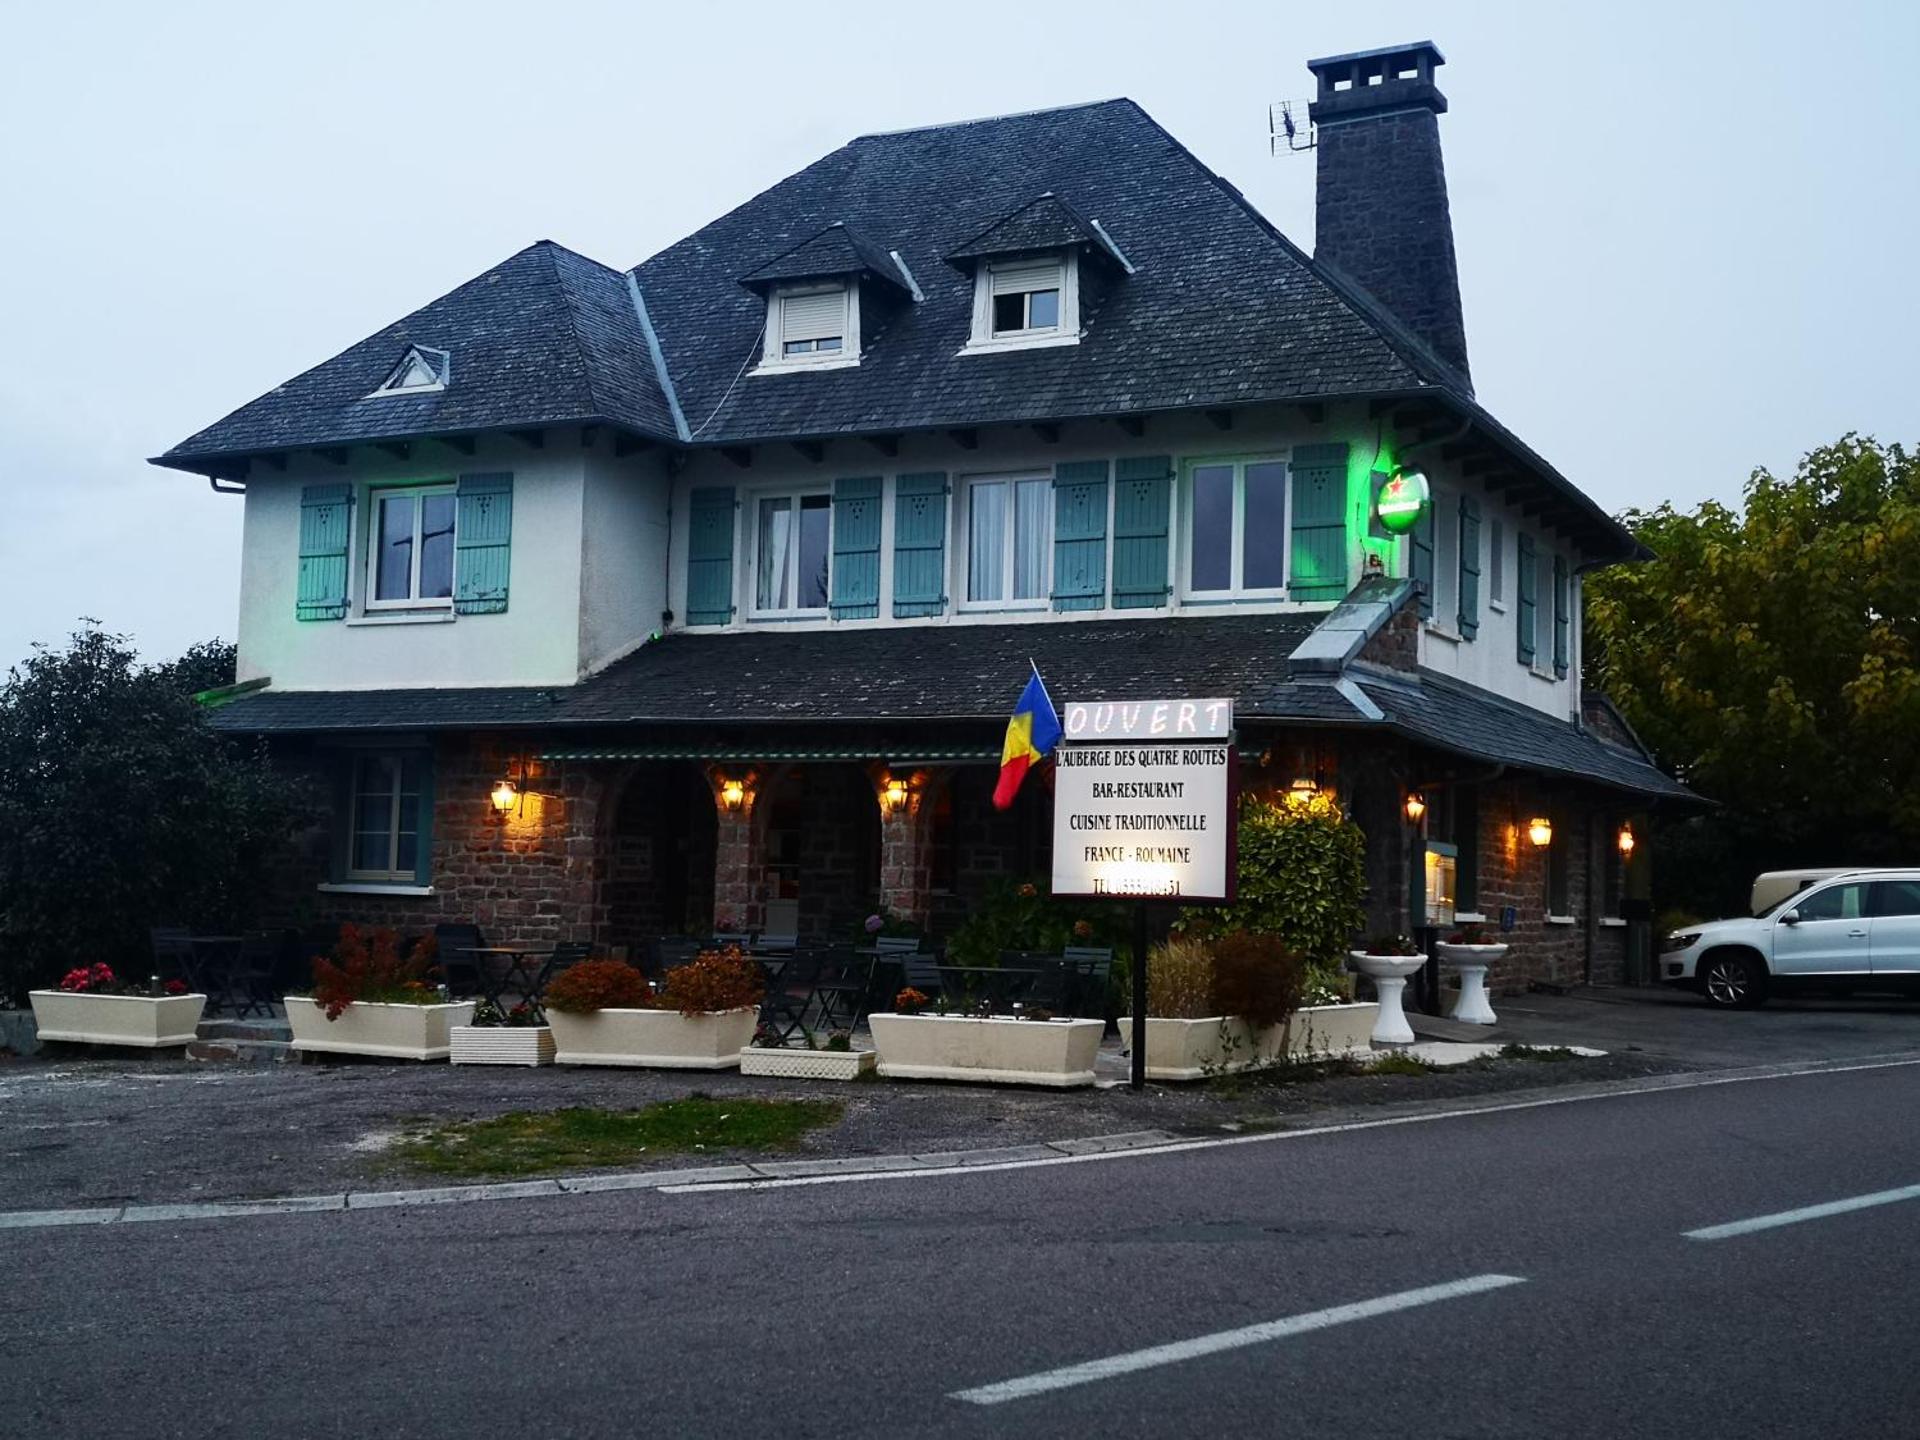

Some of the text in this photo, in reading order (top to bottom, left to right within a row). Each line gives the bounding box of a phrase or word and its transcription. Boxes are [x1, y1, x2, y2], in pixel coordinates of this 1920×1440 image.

[1069, 702, 1227, 733] OUVERT
[1056, 749, 1225, 767] L'AUBERGE DES QUATRE ROUTES
[1093, 782, 1184, 798] BAR-RESTAURANT
[1070, 815, 1206, 830] CUISINE TRADITIONNELLE
[1085, 847, 1124, 862] FRANCE
[1136, 847, 1190, 863] ROUMAINE
